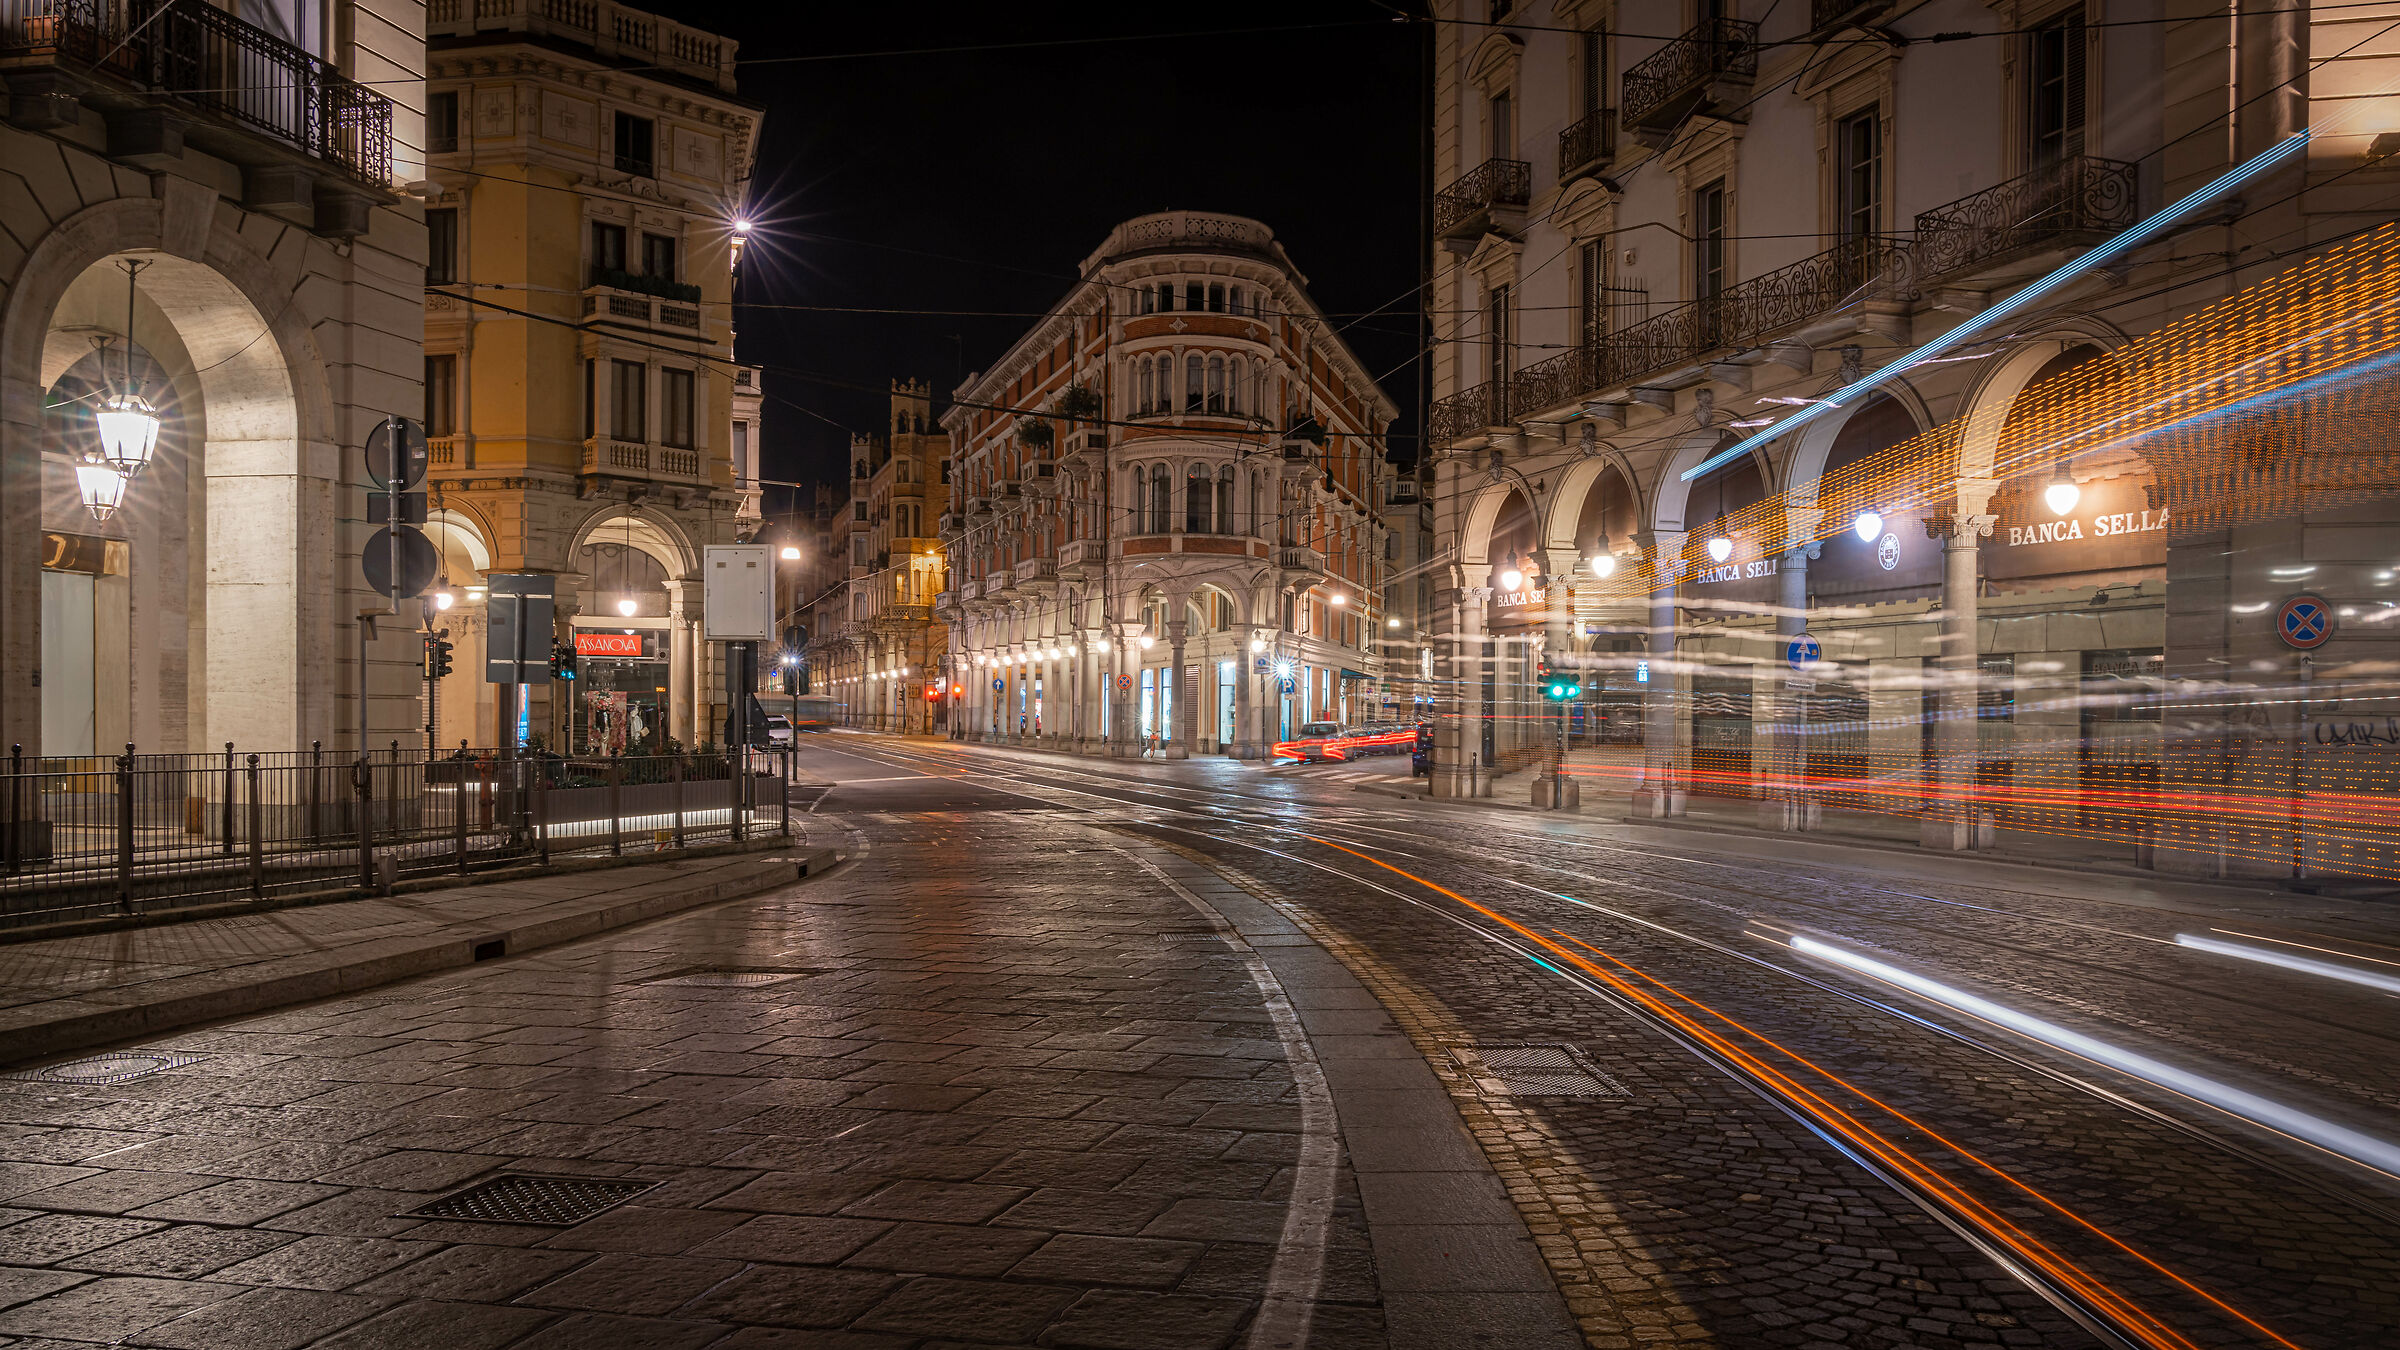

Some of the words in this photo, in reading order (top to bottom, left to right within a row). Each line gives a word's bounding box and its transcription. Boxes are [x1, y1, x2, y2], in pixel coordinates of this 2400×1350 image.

[2008, 520, 2083, 547] BANCA
[2094, 507, 2169, 537] SELLA
[1697, 564, 1741, 584] BANCA
[1497, 591, 1528, 608] BANCA
[575, 637, 637, 652] ASSANOVA
[2092, 661, 2141, 675] BANCA
[1283, 680, 1292, 692] P
